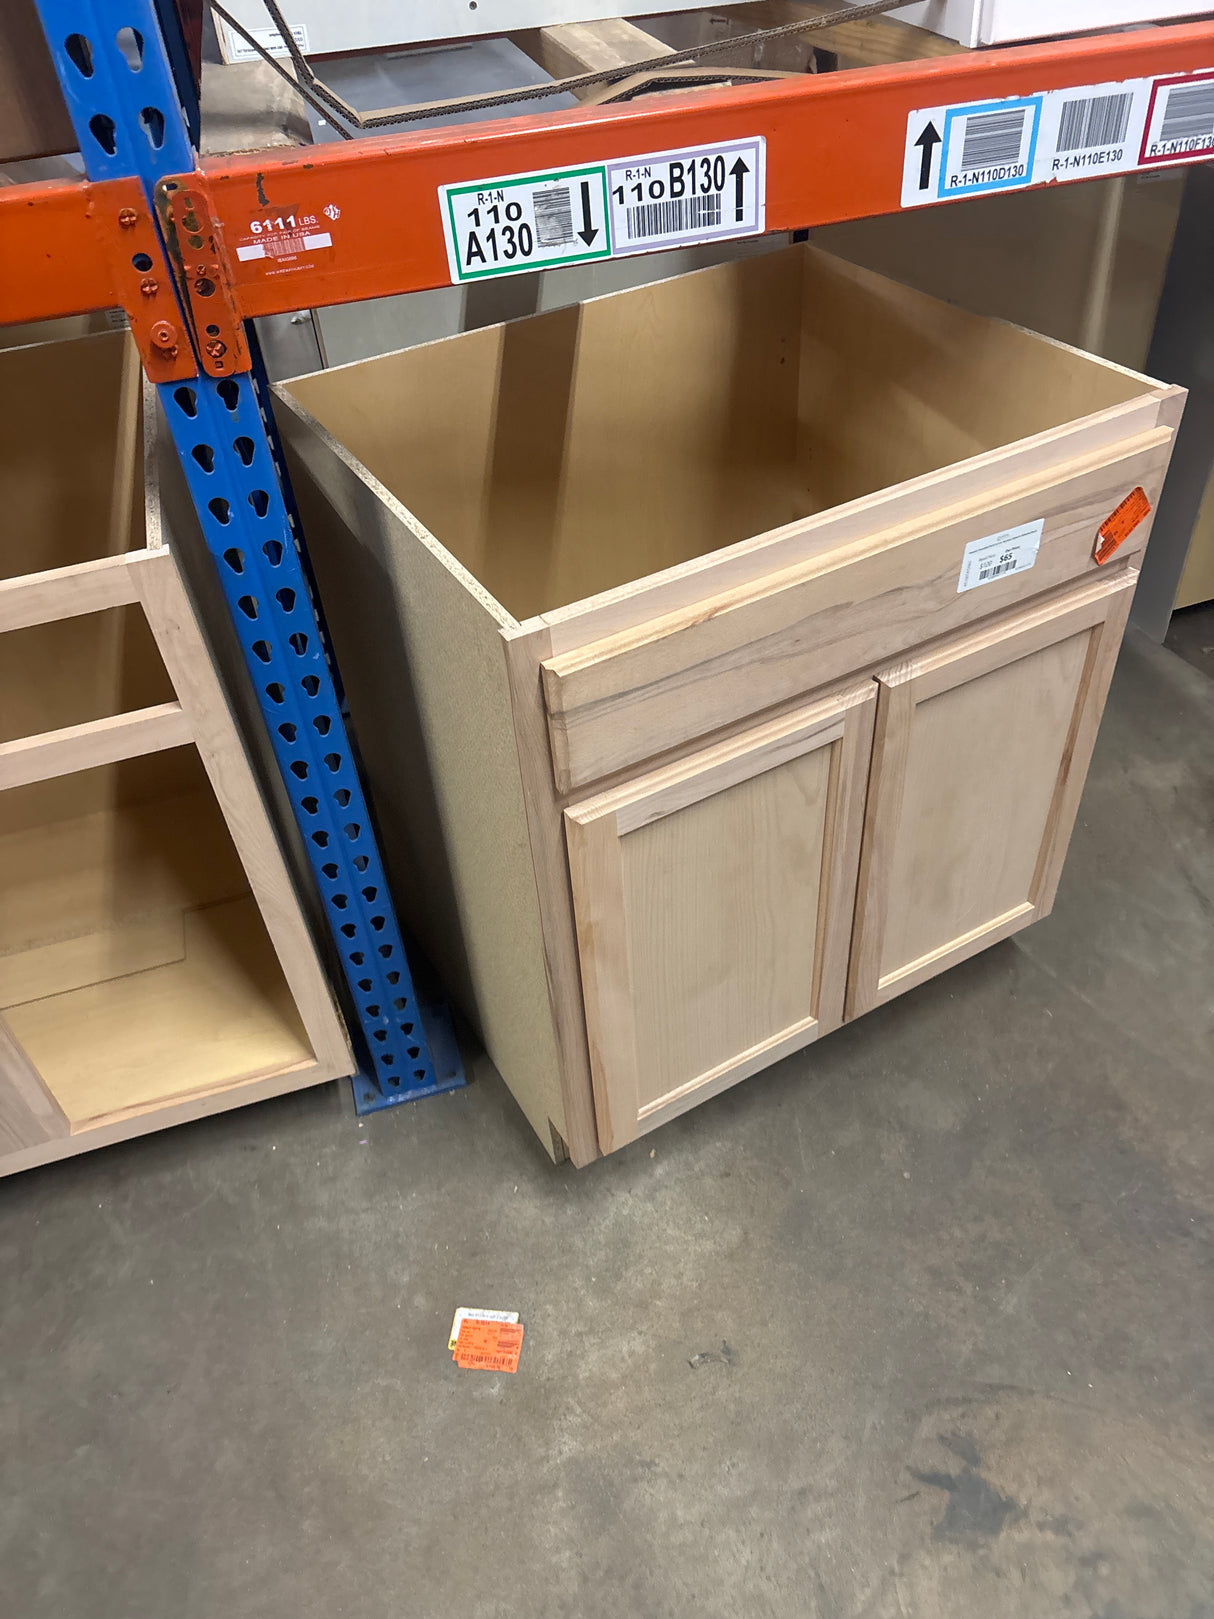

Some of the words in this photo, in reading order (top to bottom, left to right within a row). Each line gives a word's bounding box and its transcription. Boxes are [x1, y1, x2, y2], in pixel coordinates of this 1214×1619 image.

[1052, 149, 1123, 171] R-1-N110E130
[625, 167, 652, 181] R-1-N
[950, 164, 1024, 187] R-1-N110D130
[477, 190, 504, 205] R-1-N
[250, 215, 296, 234] 6111
[298, 215, 319, 226] LBS.
[467, 202, 522, 227] 110
[253, 236, 279, 244] MADE
[466, 223, 533, 266] A130
